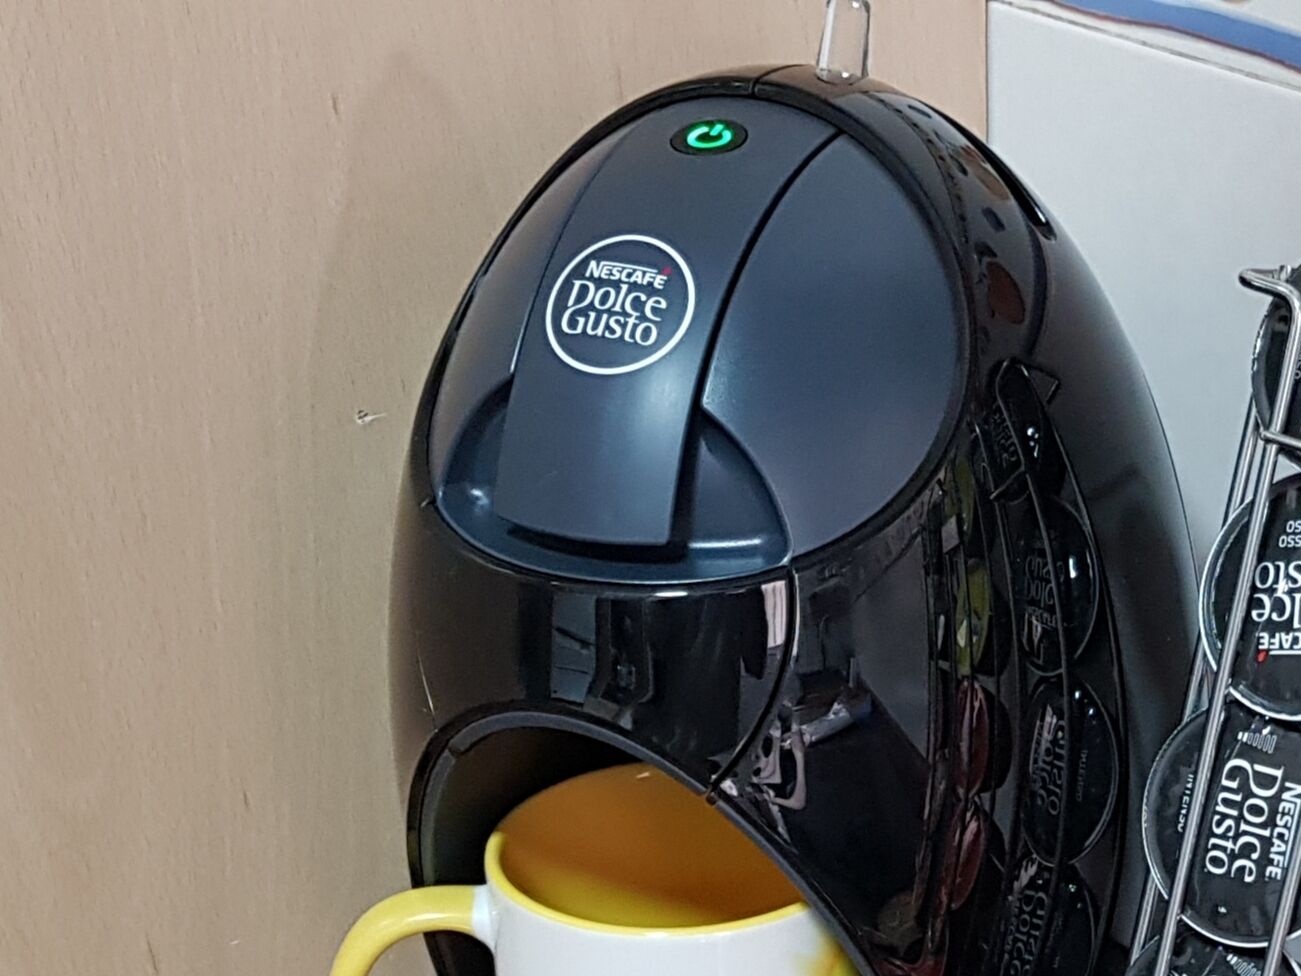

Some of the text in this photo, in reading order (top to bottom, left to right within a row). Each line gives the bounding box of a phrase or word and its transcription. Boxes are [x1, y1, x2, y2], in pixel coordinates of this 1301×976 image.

[560, 304, 660, 346] Gusto
[567, 278, 667, 322] Dolce
[1205, 758, 1252, 875] Gusto
[1231, 762, 1284, 882] Dolce
